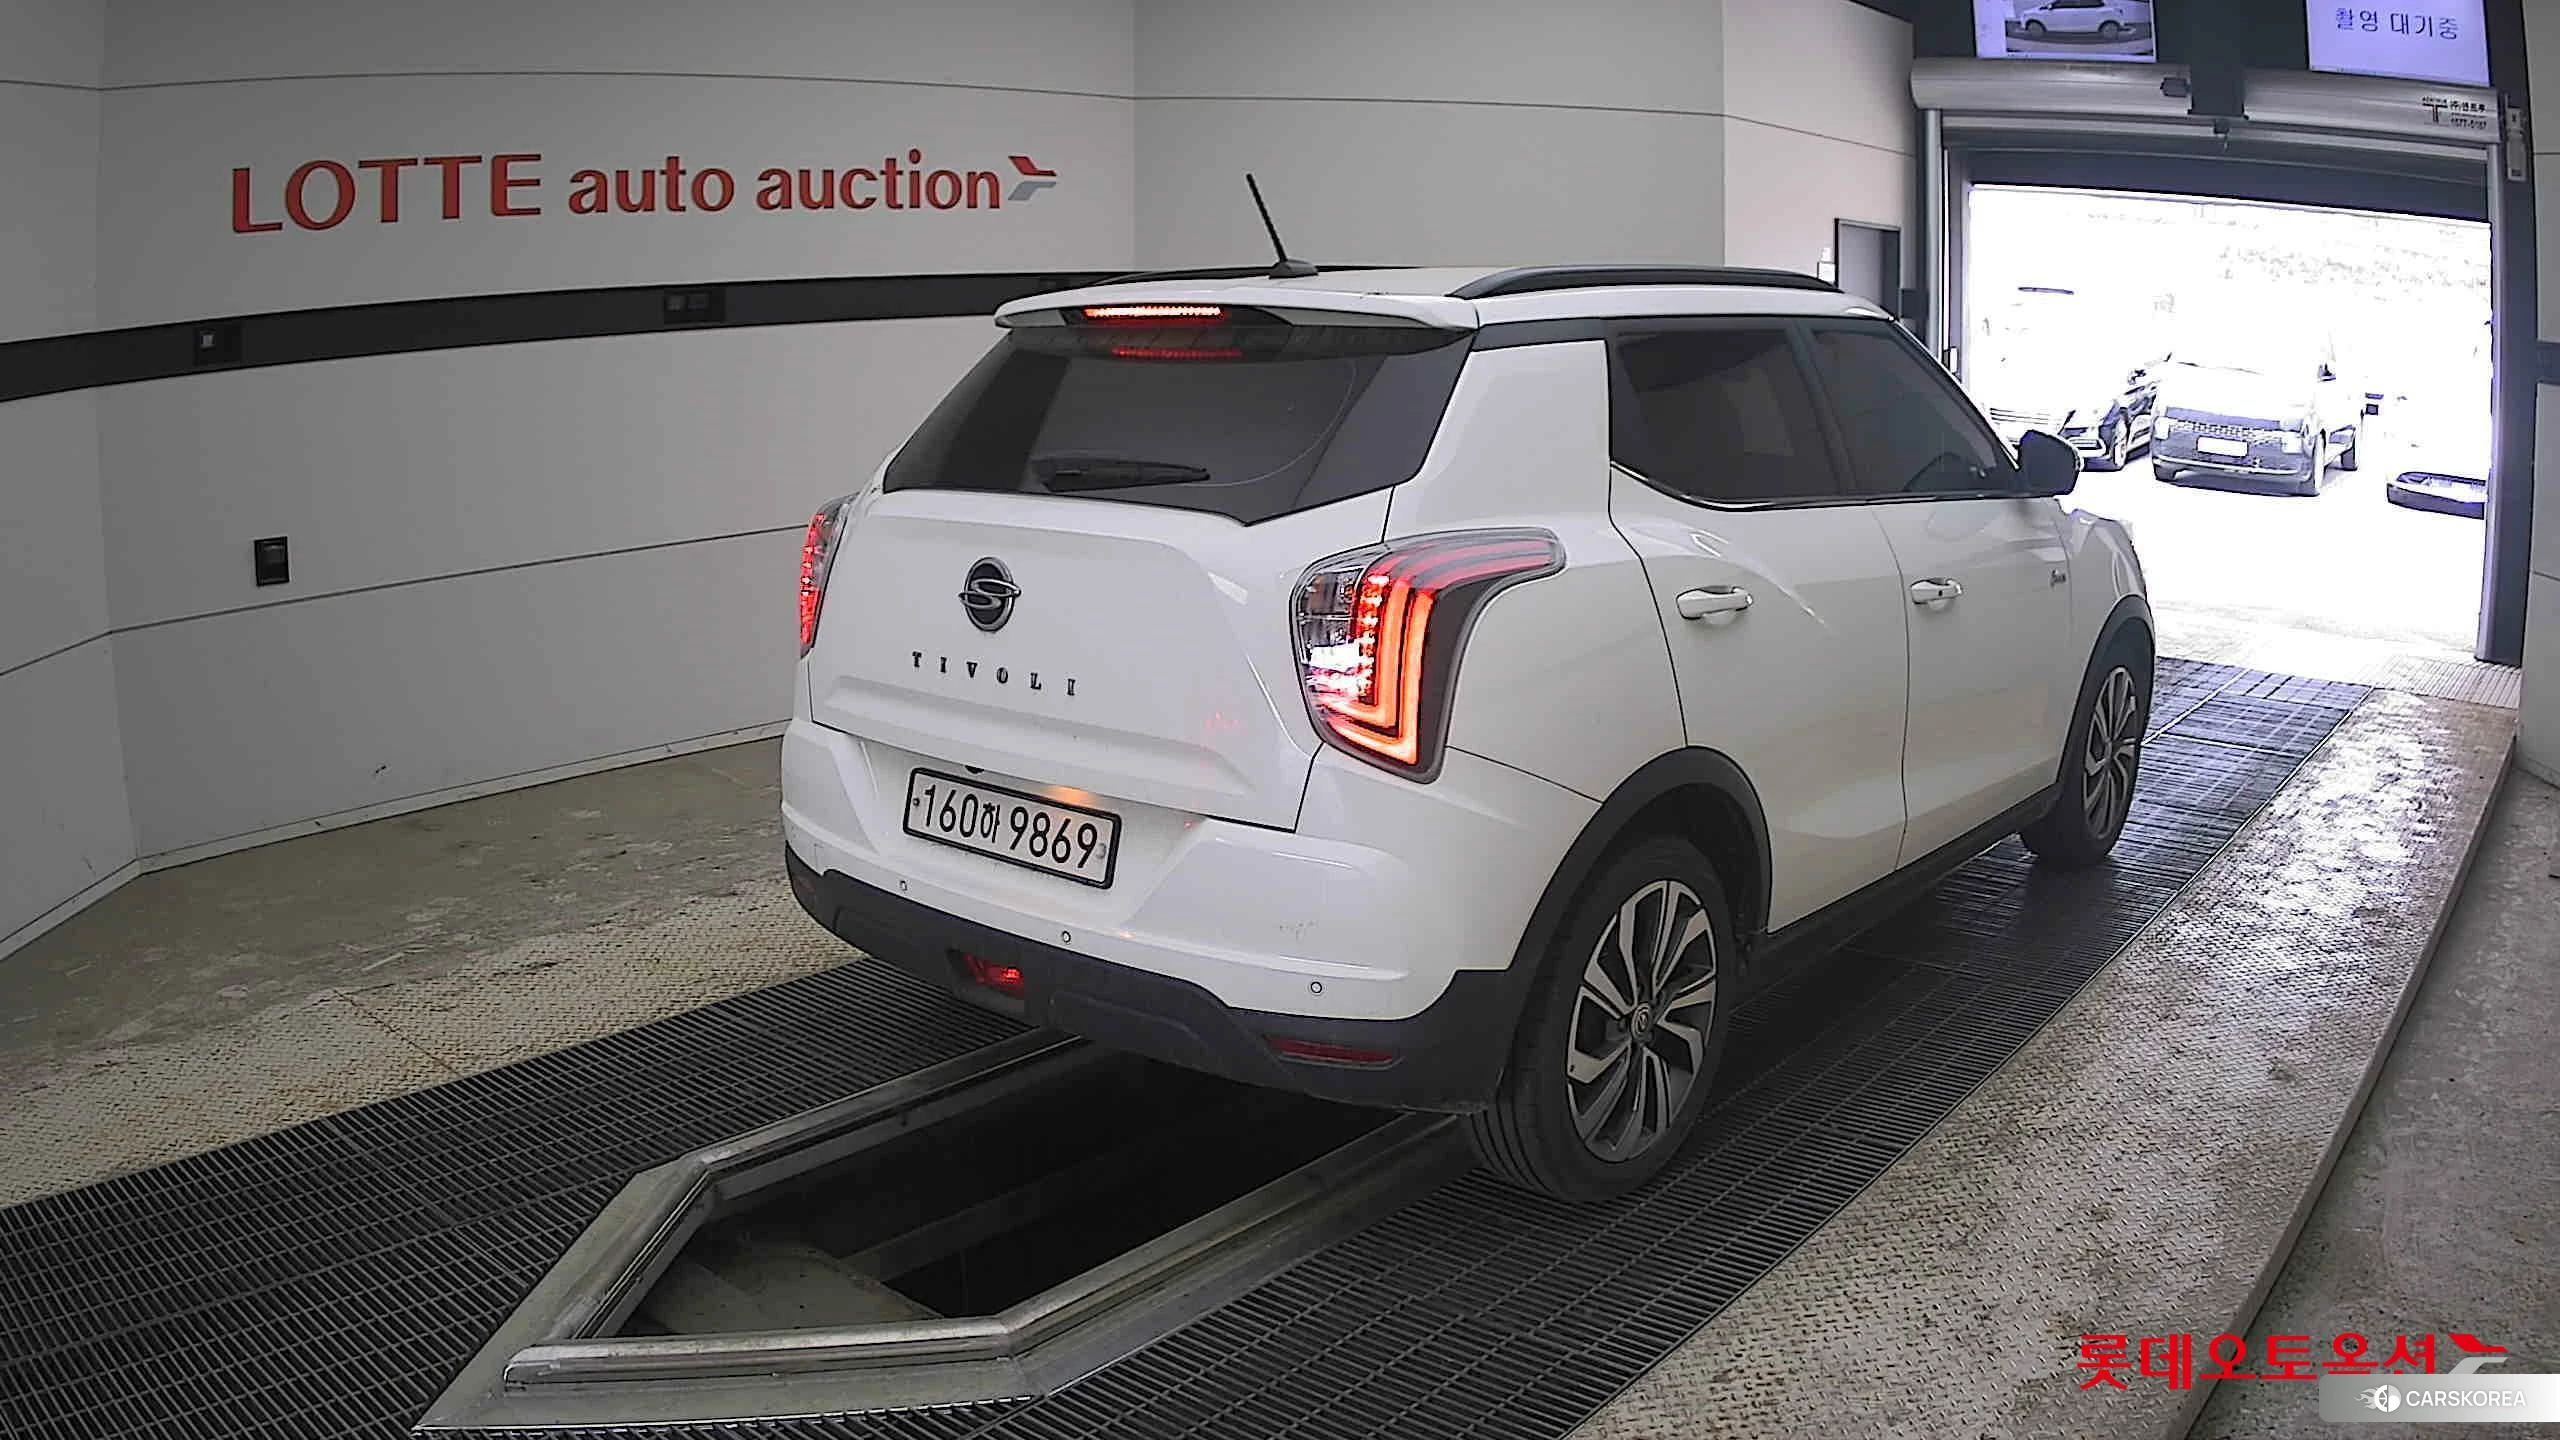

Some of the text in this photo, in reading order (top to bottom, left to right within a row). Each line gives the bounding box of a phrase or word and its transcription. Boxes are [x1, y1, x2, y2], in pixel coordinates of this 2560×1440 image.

[2336, 7, 2459, 40] 촬영 대기중
[232, 148, 1001, 233] LOTTE auto auction
[911, 650, 1078, 697] TIVOLI
[924, 784, 1098, 869] 160하 9869
